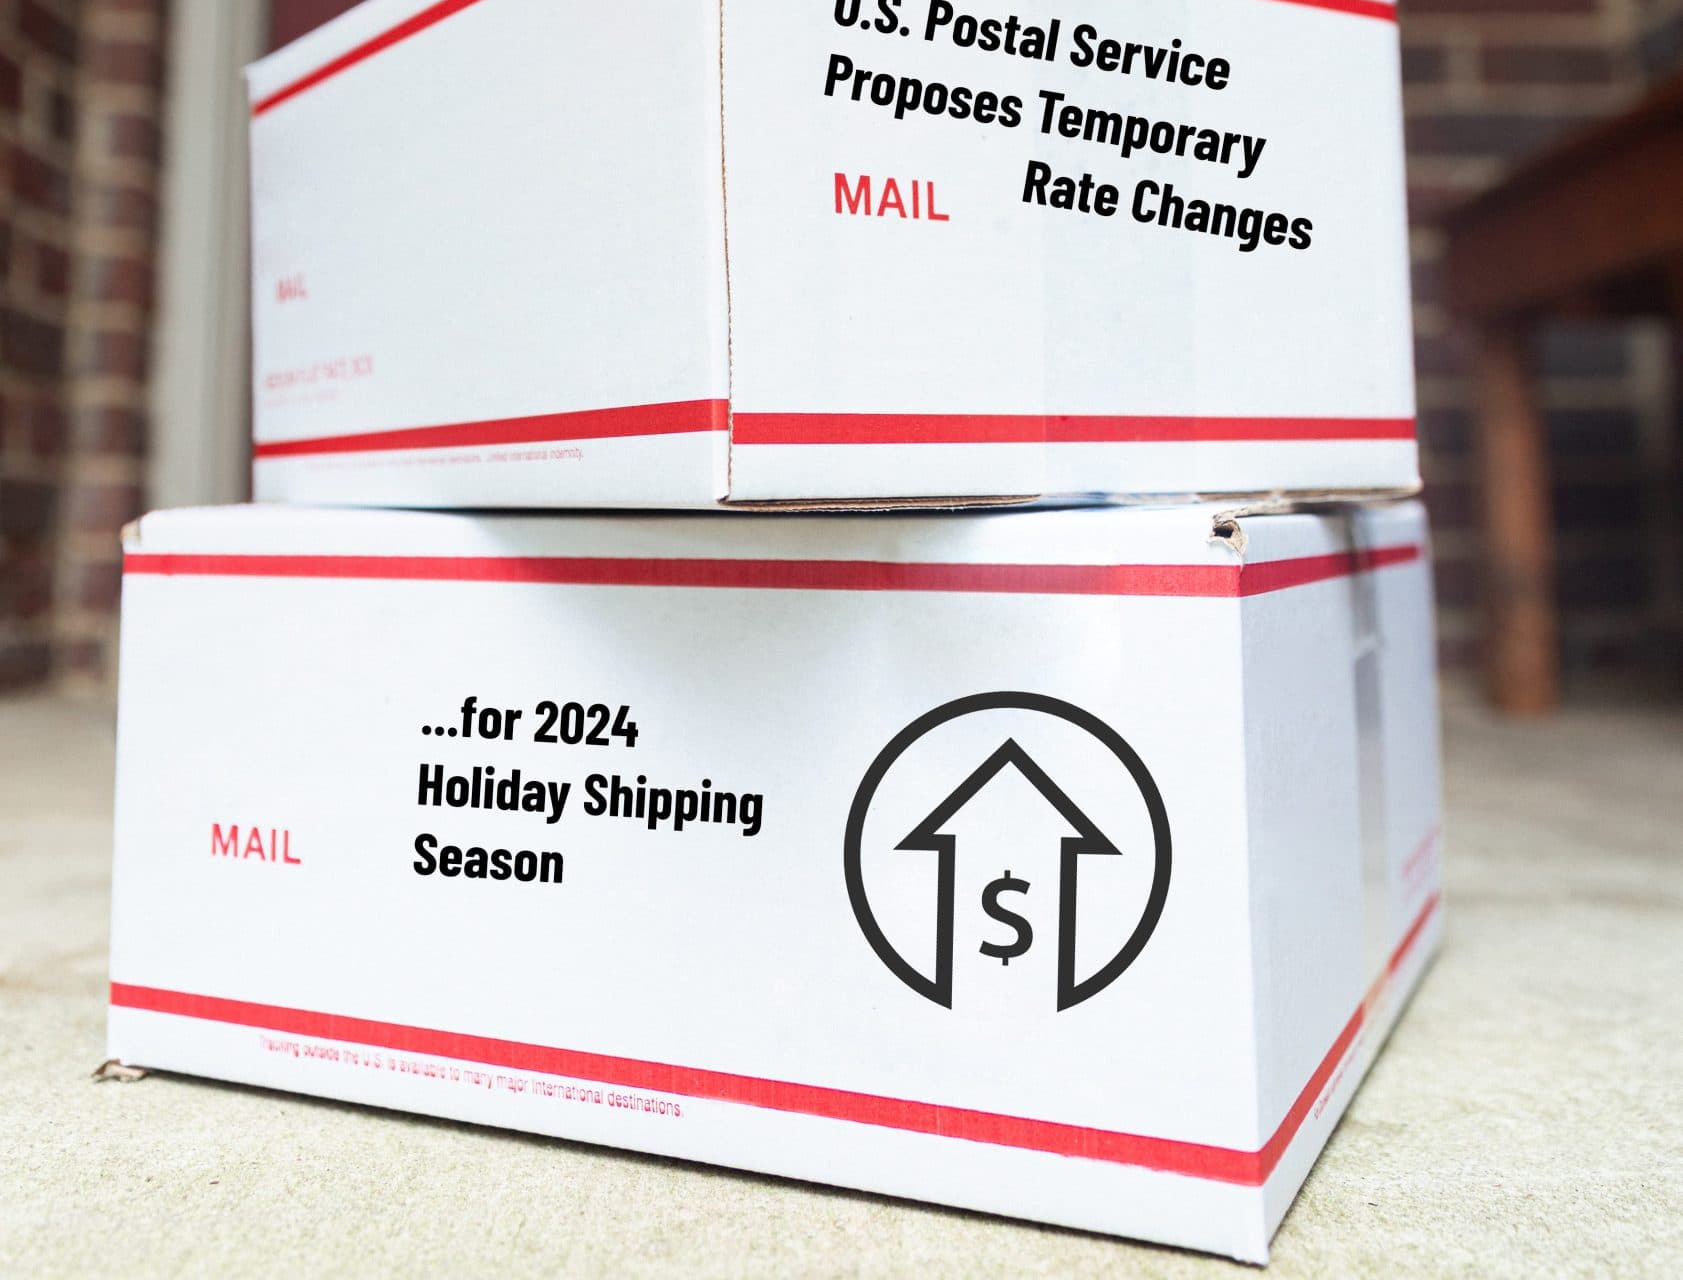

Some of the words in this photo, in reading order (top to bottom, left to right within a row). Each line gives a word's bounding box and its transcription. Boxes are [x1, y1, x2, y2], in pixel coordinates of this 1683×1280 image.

[834, 172, 950, 222] MAIL
[211, 821, 302, 865] MAIL
[463, 1069, 494, 1090] many
[496, 1073, 528, 1094] major
[607, 1090, 685, 1118] destinations.
